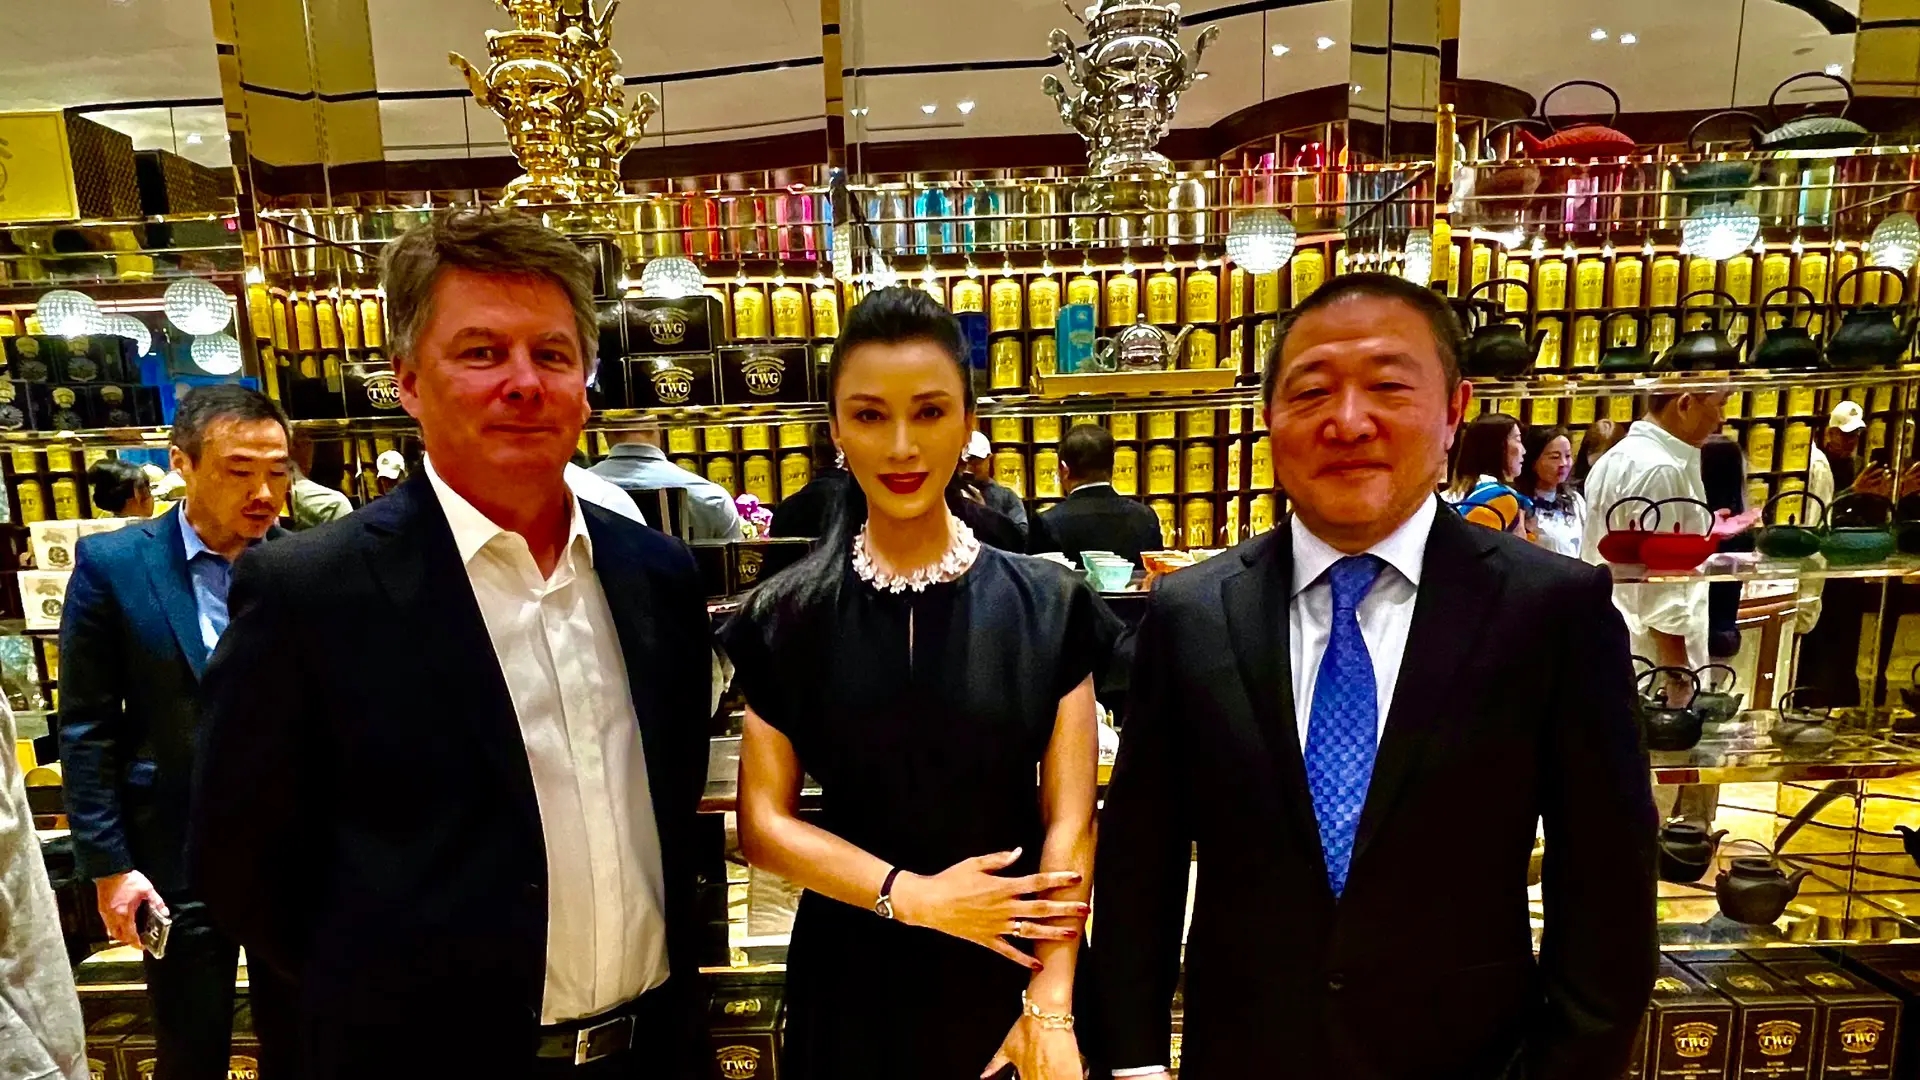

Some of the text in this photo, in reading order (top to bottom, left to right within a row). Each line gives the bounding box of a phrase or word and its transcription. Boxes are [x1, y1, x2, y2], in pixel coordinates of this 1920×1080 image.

[651, 323, 682, 334] TWG
[748, 373, 778, 385] TWG
[369, 387, 400, 399] TWG
[659, 382, 688, 393] TWG
[1678, 1037, 1709, 1048] TWG
[1763, 1035, 1793, 1046] TWG
[1844, 1033, 1876, 1043] TWG
[723, 1060, 755, 1070] TWG
[227, 1070, 255, 1080] TWG
